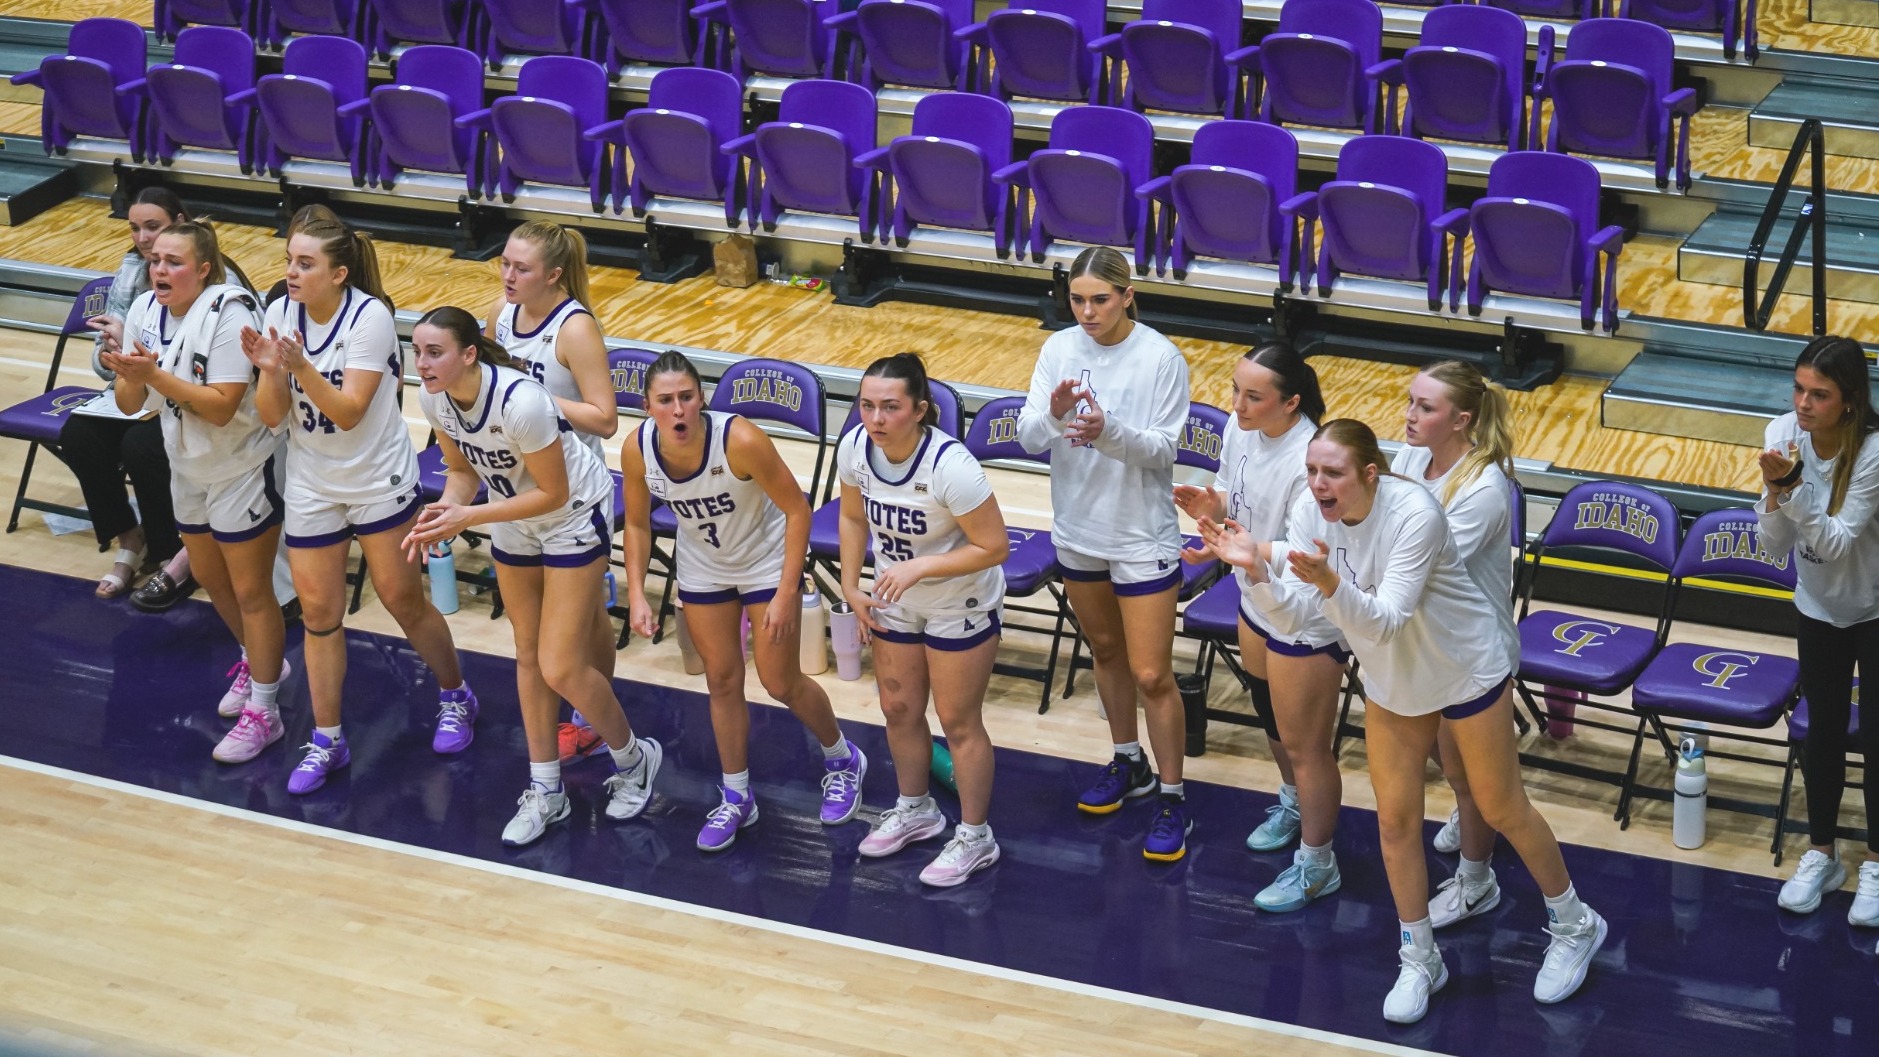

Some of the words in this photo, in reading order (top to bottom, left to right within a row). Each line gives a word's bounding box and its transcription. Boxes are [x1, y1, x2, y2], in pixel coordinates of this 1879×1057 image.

[744, 369, 783, 380] COLLEGE
[730, 377, 803, 412] IDAHO
[1592, 493, 1638, 507] COLLEGE
[1641, 503, 1651, 513] OF
[698, 522, 721, 549] 3
[1574, 501, 1659, 545] IDAHO
[878, 532, 915, 562] 25
